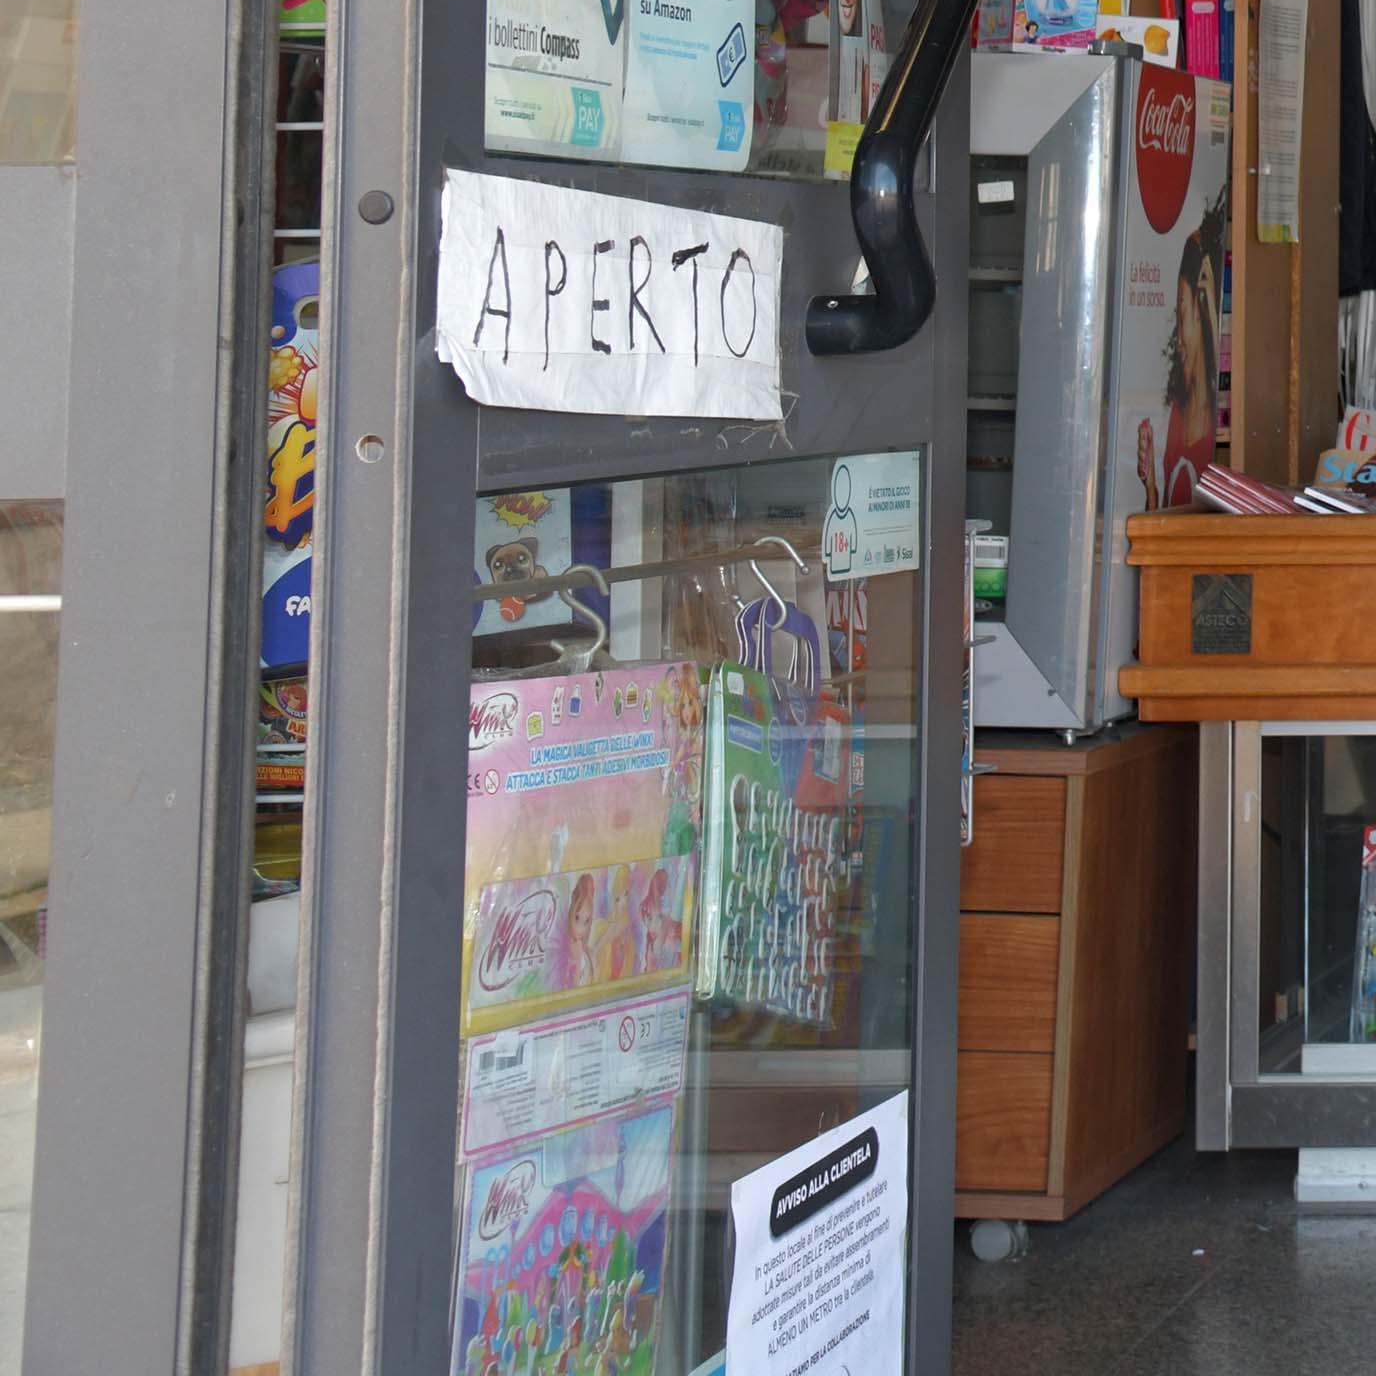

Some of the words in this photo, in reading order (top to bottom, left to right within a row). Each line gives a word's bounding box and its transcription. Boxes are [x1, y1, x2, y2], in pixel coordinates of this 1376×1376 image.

[494, 17, 538, 53] bollettini
[540, 26, 581, 62] Compass
[640, 0, 652, 15] su
[653, 0, 692, 21] Amazon
[577, 105, 602, 132] PAY
[1138, 87, 1195, 156] Coca-Cola
[473, 225, 758, 371] APERTO
[834, 531, 849, 553] 18+
[505, 774, 545, 792] ATTACCA
[552, 766, 581, 785] STACCA
[531, 747, 542, 764] LA
[543, 745, 573, 763] MAGICA
[610, 736, 633, 753] DELLE
[776, 1184, 807, 1219] AVVISO
[808, 1170, 830, 1197] ALLA
[830, 1142, 872, 1183] CLIENTELA
[754, 1264, 762, 1281] In
[762, 1251, 787, 1275] questo
[787, 1235, 806, 1259] locale
[806, 1229, 814, 1246] al
[813, 1224, 826, 1241] fine
[826, 1215, 833, 1233] di
[833, 1201, 861, 1229] prevenire
[866, 1179, 888, 1205] tutelare
[764, 1274, 774, 1296] LA
[775, 1257, 802, 1288] SALUTE
[802, 1242, 823, 1269] DELLE
[824, 1221, 855, 1254] PERSONE
[855, 1206, 881, 1230] vengono
[751, 1295, 780, 1326] adottate
[781, 1281, 802, 1304] misure
[803, 1271, 814, 1288] tali
[814, 1264, 823, 1281] da
[823, 1250, 845, 1274] evitare
[768, 1324, 797, 1358] ALMENO
[797, 1316, 809, 1335] UN
[809, 1299, 833, 1328] METRO
[833, 1294, 843, 1309] tra
[843, 1287, 850, 1302] la
[778, 1298, 807, 1330] garantire
[807, 1291, 814, 1306] la
[814, 1273, 841, 1301] distanza
[841, 1257, 865, 1281] minima
[864, 1249, 872, 1266] di
[810, 1352, 820, 1367] PER
[827, 1308, 871, 1353] COLLABORAZIONE
